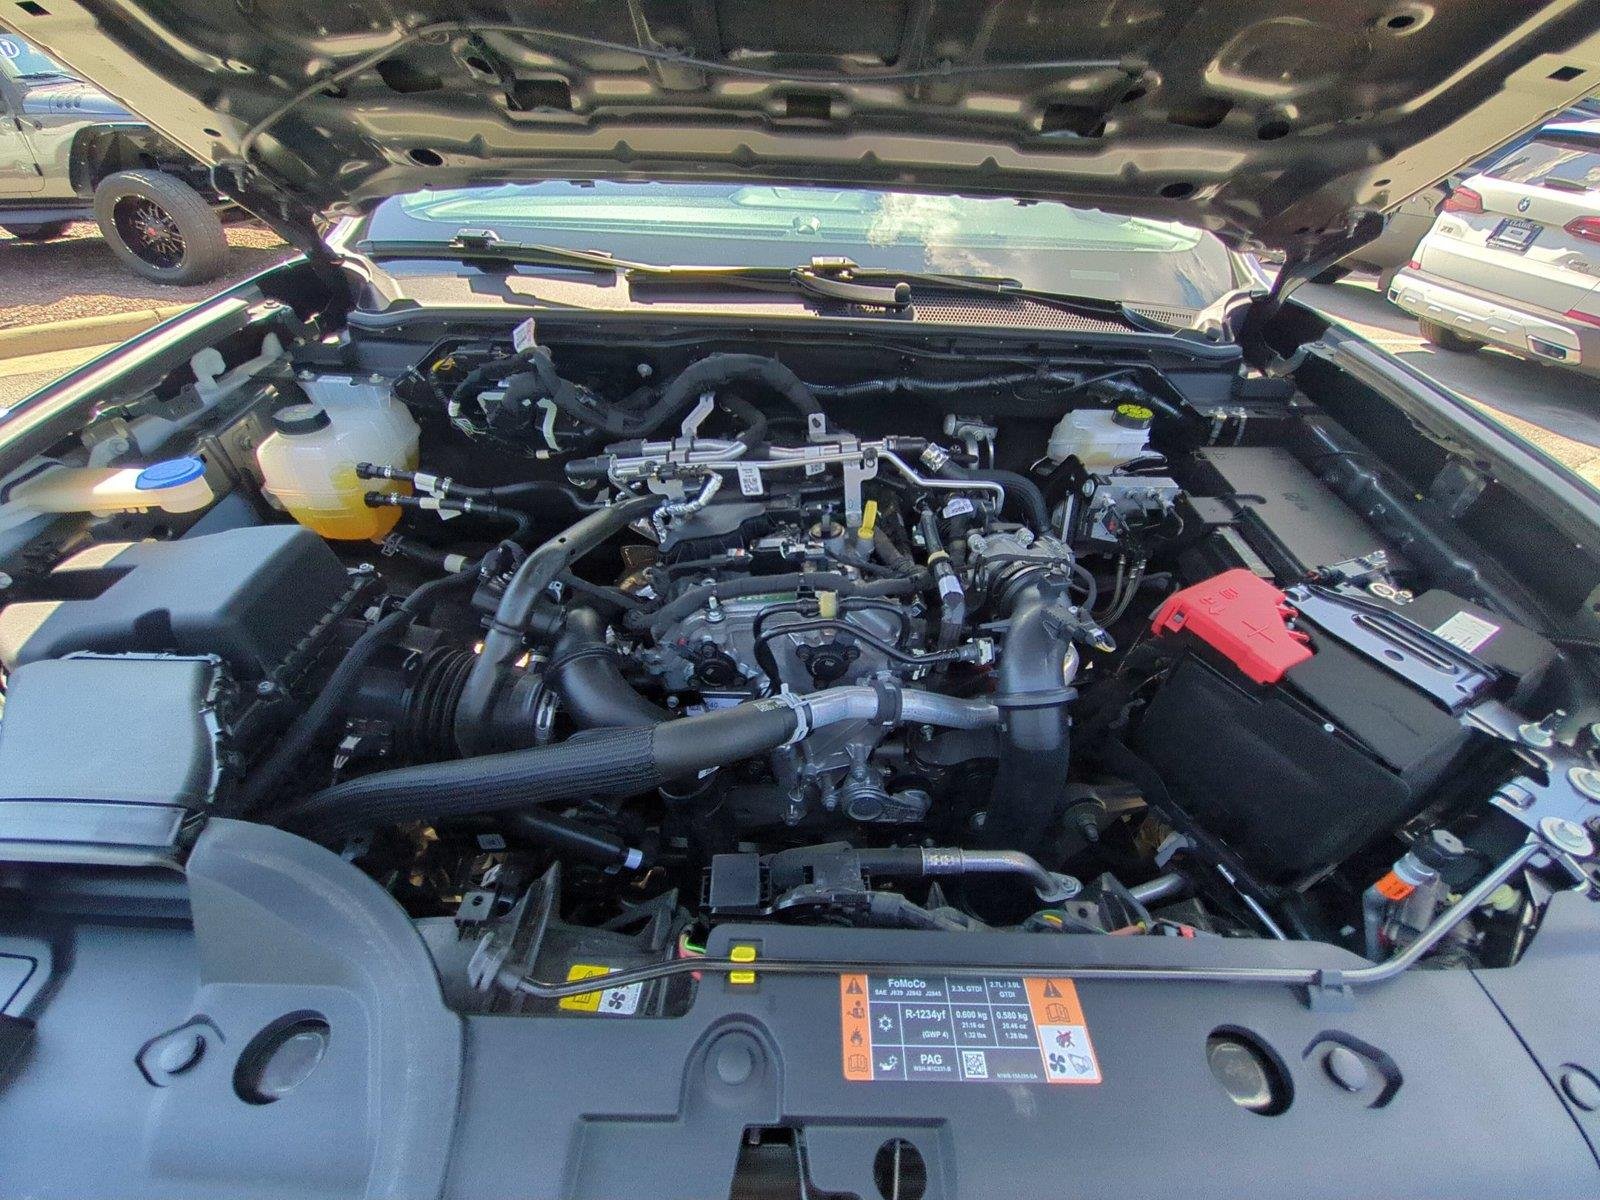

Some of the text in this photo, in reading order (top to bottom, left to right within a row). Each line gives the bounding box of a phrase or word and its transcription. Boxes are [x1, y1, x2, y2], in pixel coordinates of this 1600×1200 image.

[888, 978, 926, 989] FoMoCo
[905, 1009, 946, 1021] R-1234yf
[956, 1010, 988, 1021] 0.600 kg
[996, 1011, 1028, 1022] 0.580 kg
[922, 1031, 941, 1039] (GWP
[920, 1054, 943, 1065] PAG
